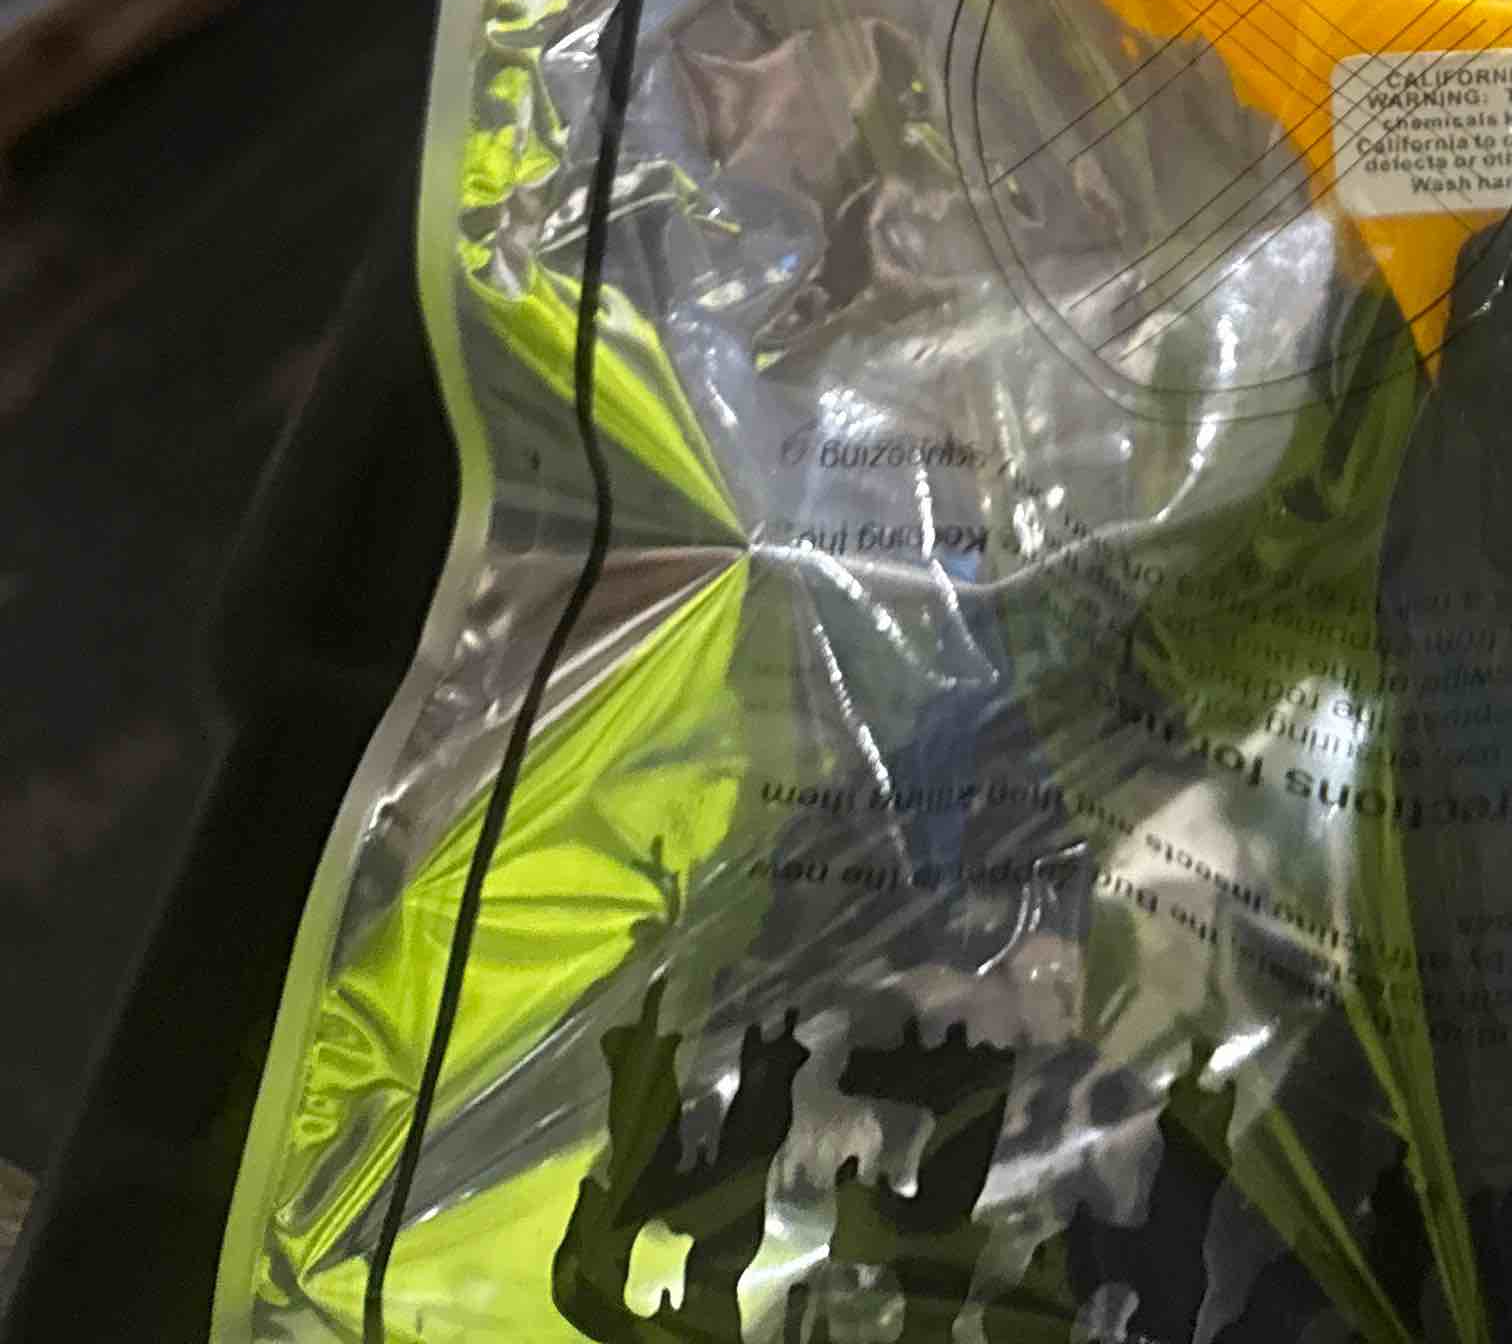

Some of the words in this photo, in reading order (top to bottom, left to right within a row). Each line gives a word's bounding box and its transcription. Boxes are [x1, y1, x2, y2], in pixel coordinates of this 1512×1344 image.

[1366, 86, 1489, 109] WARNING:
[1382, 110, 1498, 132] chemicals
[1355, 130, 1467, 154] California
[1473, 131, 1494, 148] to
[1362, 151, 1446, 173] defects
[1453, 152, 1477, 168] or
[1410, 172, 1469, 192] Wash
